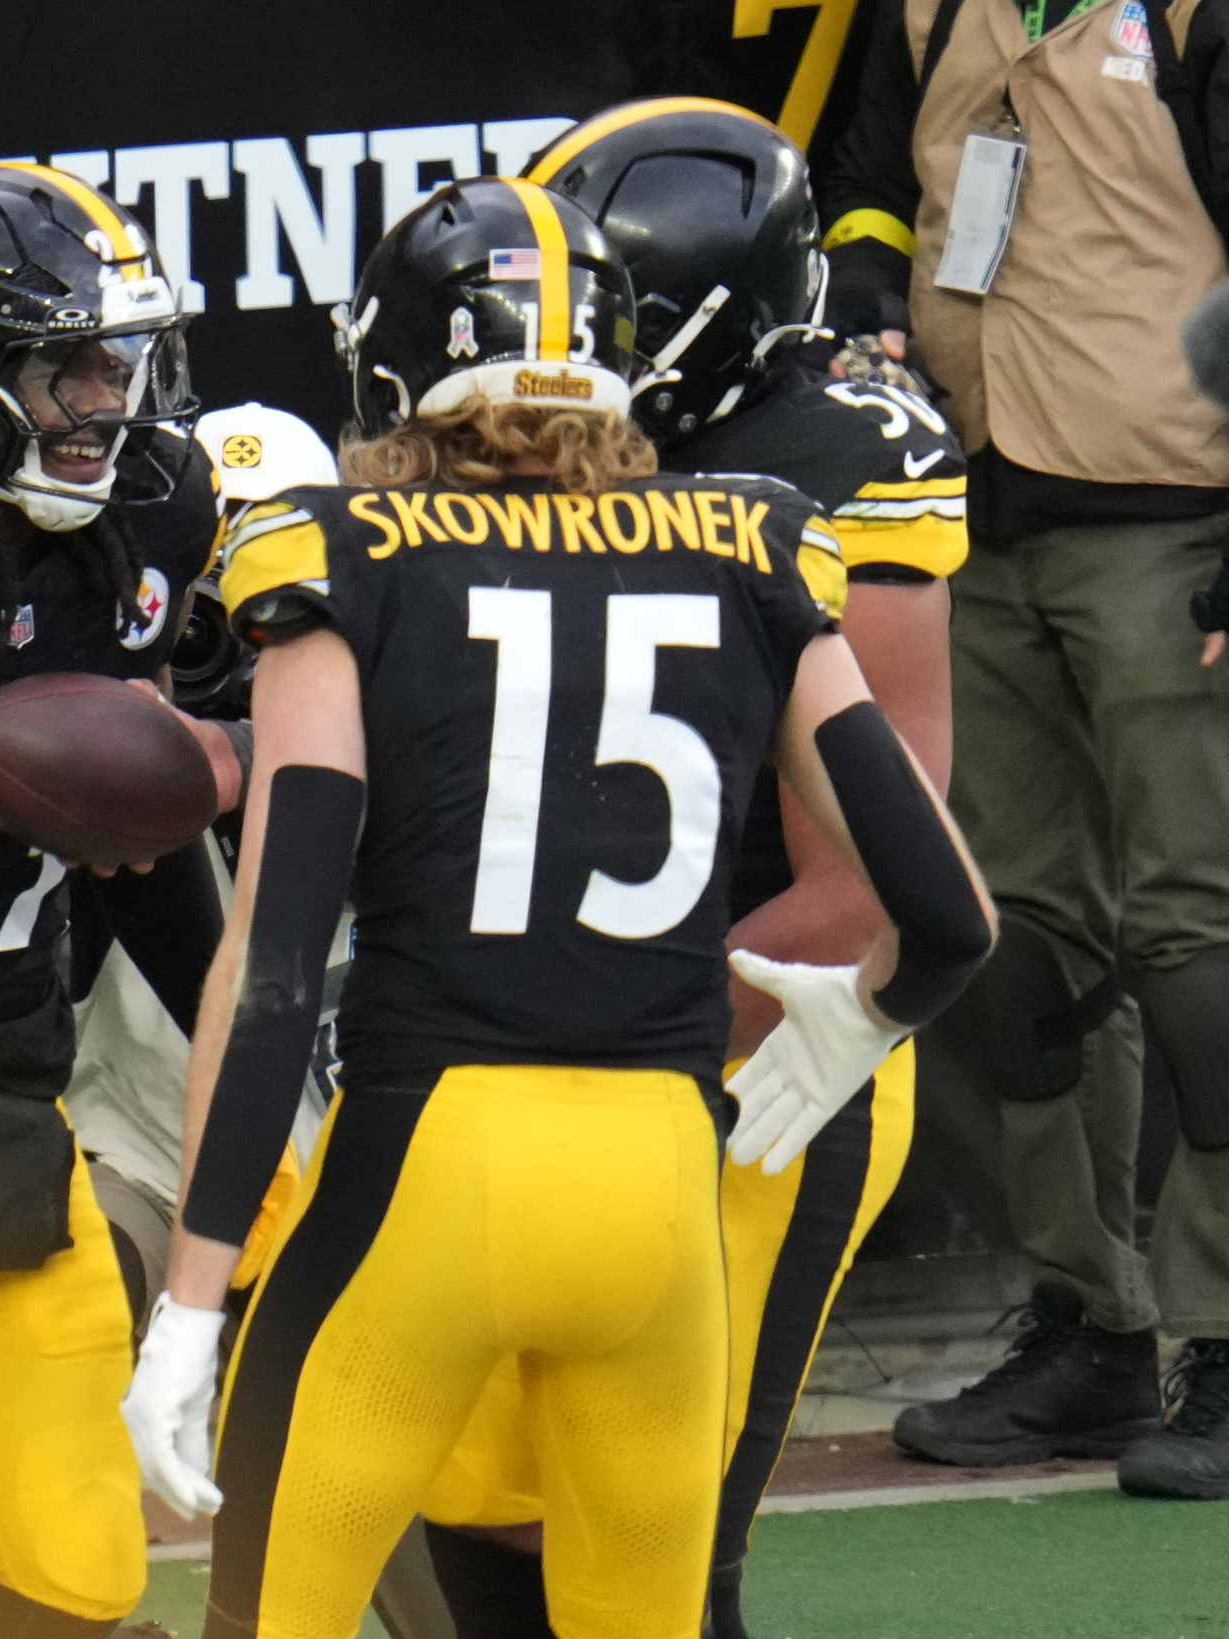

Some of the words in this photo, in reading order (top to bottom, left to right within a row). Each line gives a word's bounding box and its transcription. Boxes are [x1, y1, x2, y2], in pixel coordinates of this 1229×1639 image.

[522, 302, 596, 363] 15
[348, 489, 772, 574] SKOWRONEK
[468, 586, 721, 939] 15
